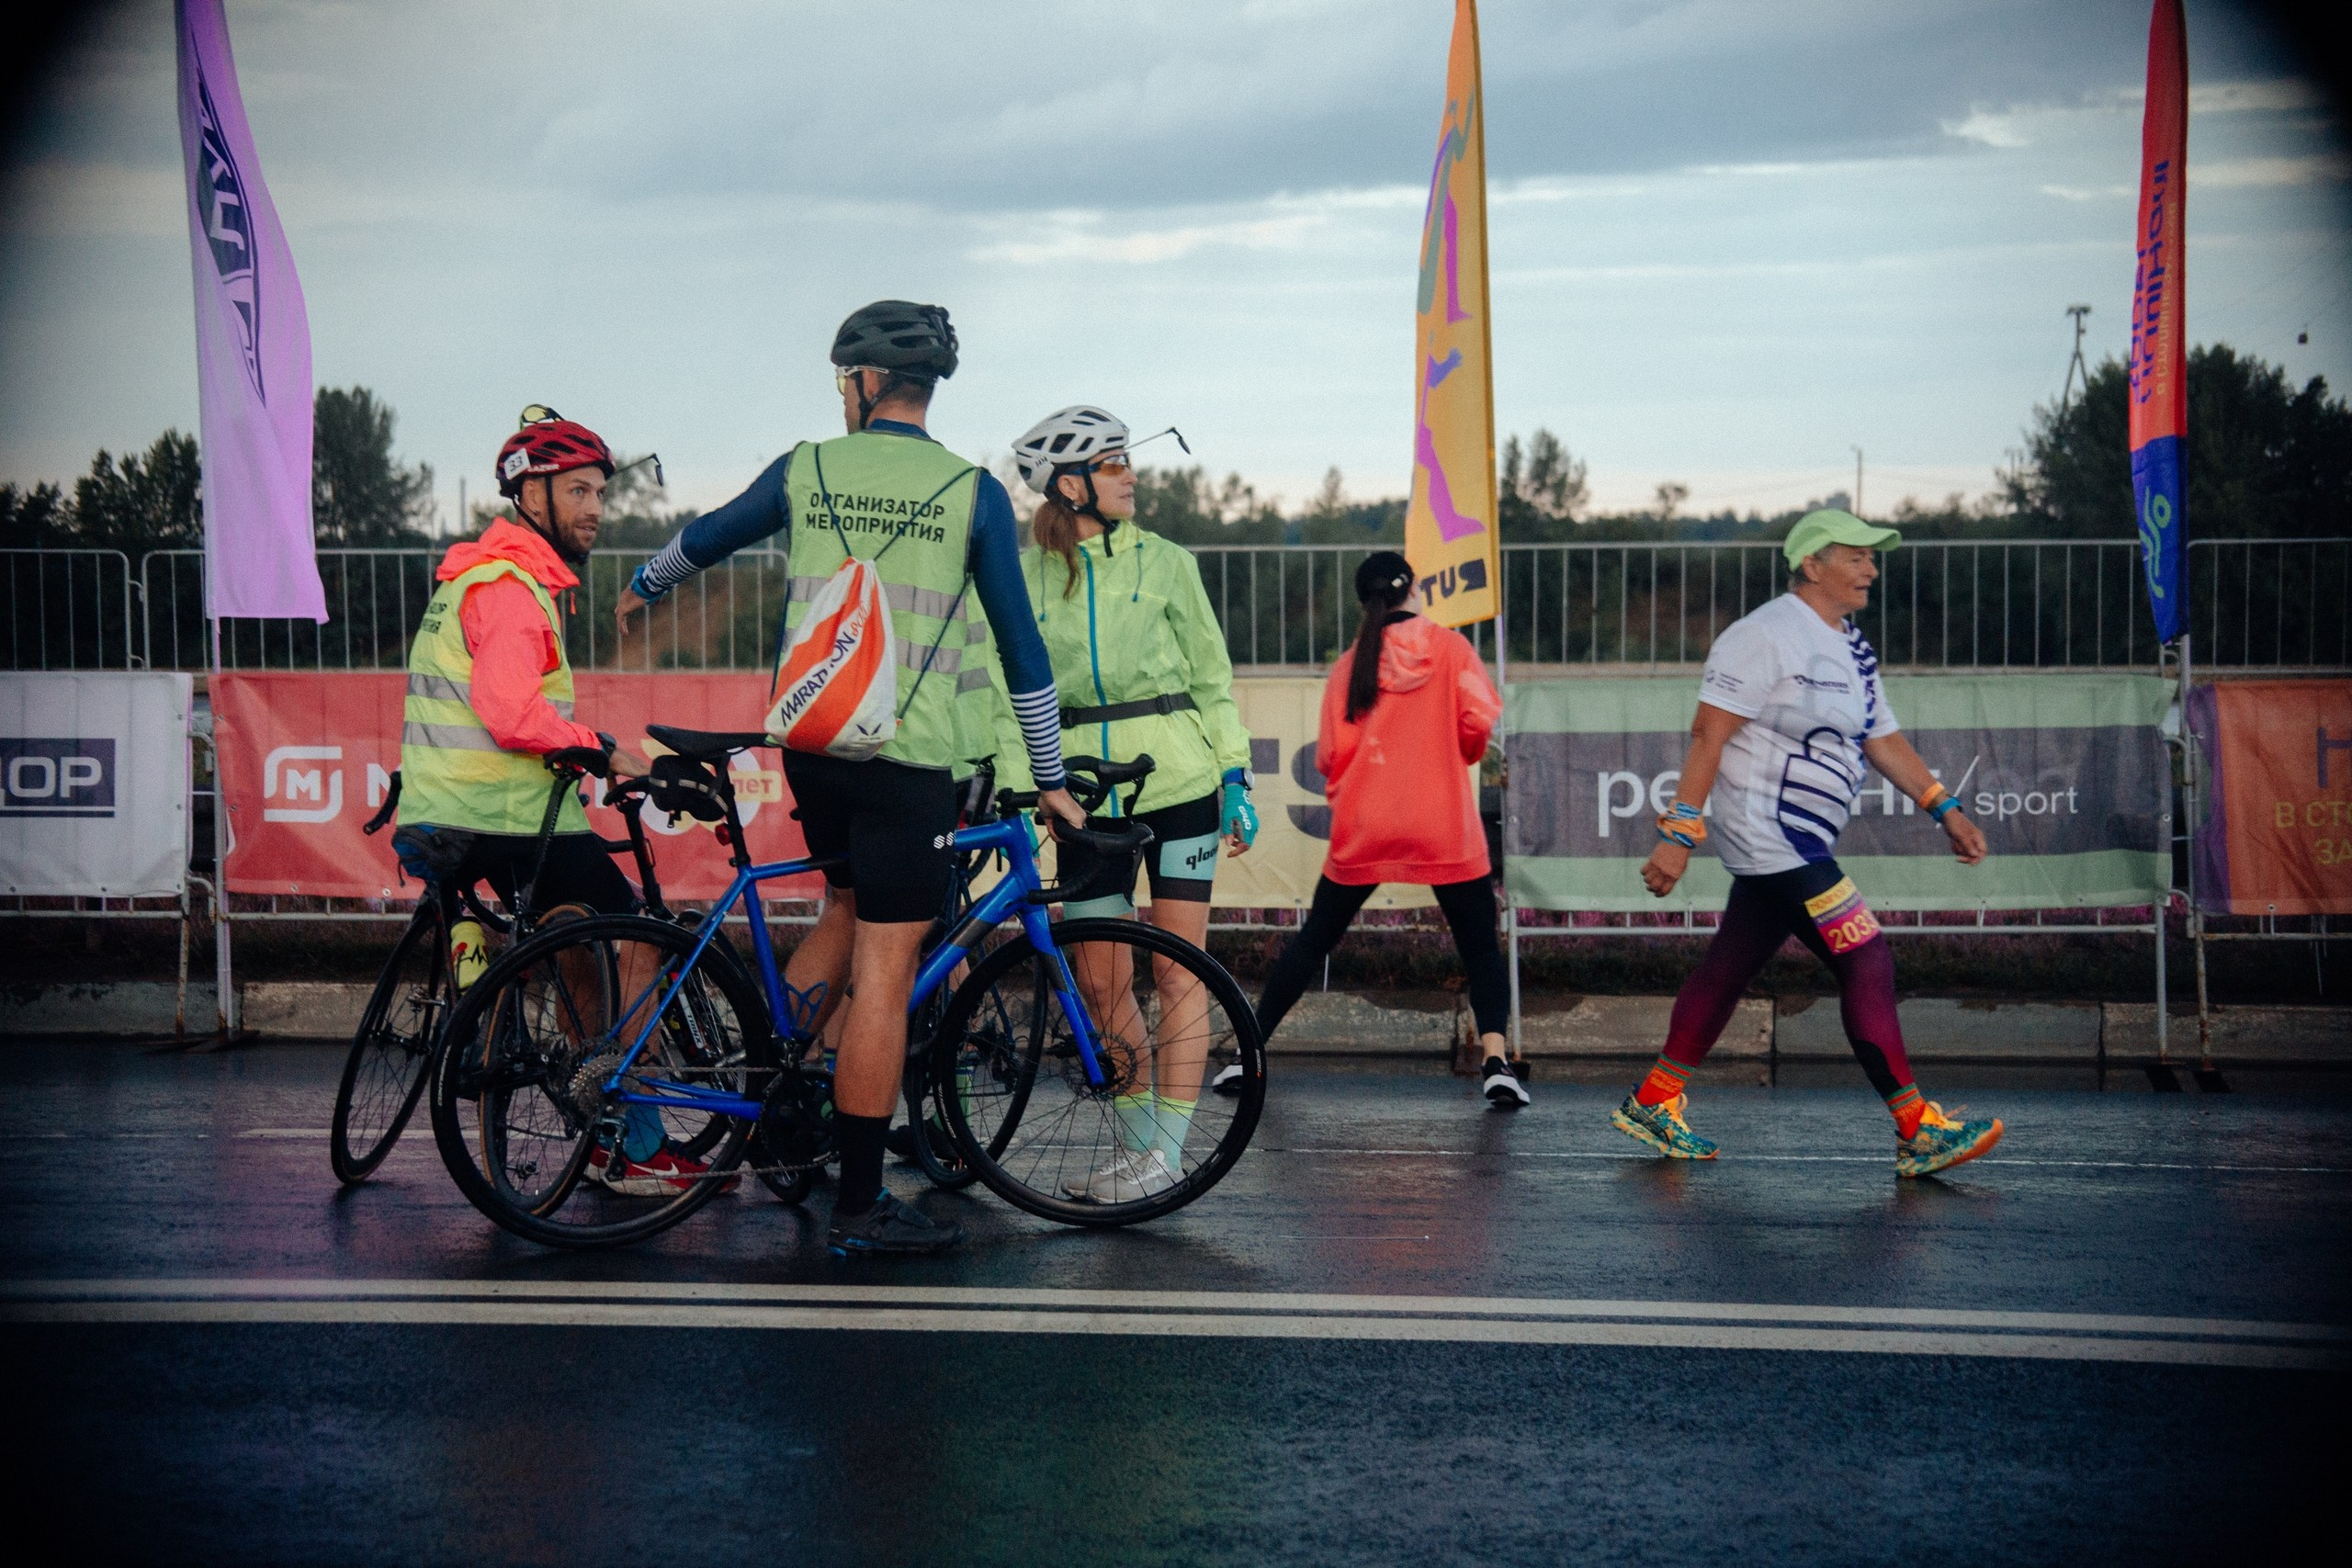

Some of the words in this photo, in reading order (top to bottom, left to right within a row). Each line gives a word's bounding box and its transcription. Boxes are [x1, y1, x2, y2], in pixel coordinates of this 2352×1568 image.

[810, 492, 944, 520] ОРГАНИЗАТОР
[806, 513, 945, 544] МЕРОПРИЯТИЯ
[781, 631, 855, 728] MARATON
[0, 756, 102, 801] ОР
[1975, 786, 2078, 820] sport
[2276, 801, 2295, 828] В
